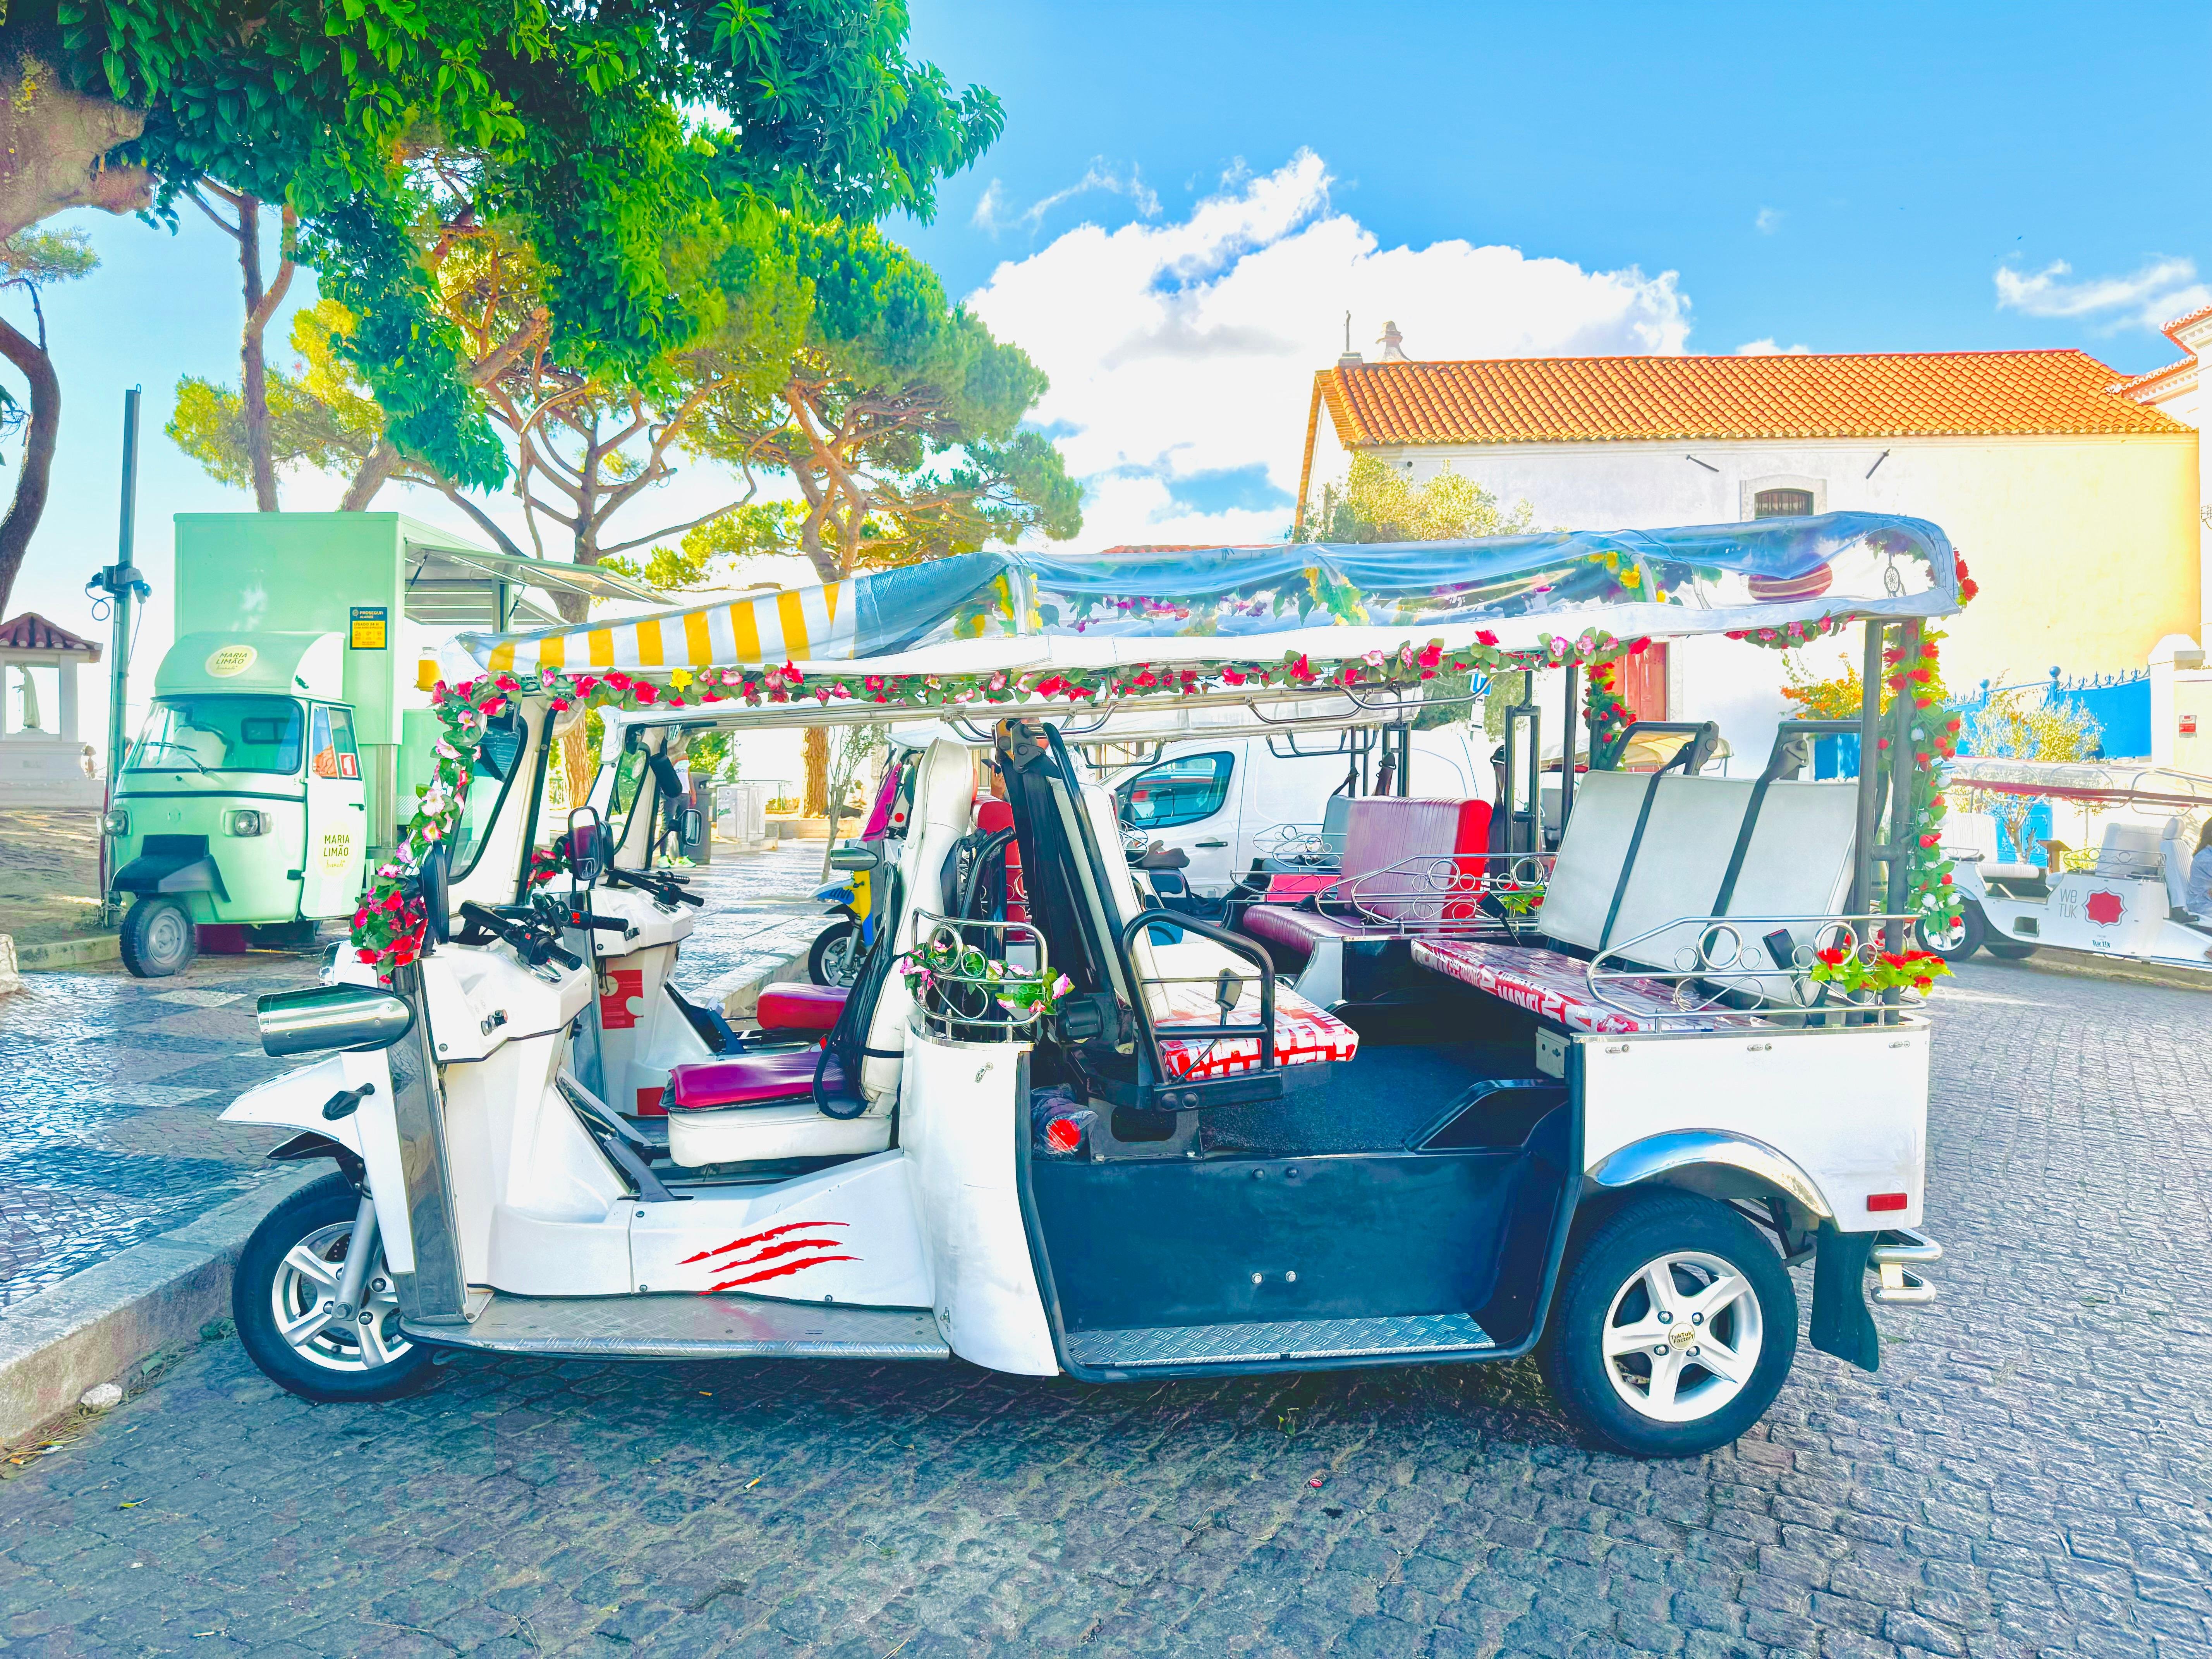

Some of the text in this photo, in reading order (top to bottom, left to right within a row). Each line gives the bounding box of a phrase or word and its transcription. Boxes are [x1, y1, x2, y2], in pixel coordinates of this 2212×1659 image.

[325, 835, 350, 844] MARIA
[324, 845, 349, 857] LIMÃO
[2059, 903, 2078, 919] TUK
[1671, 1331, 1692, 1340] TukTuk
[1673, 1333, 1693, 1343] Factory
